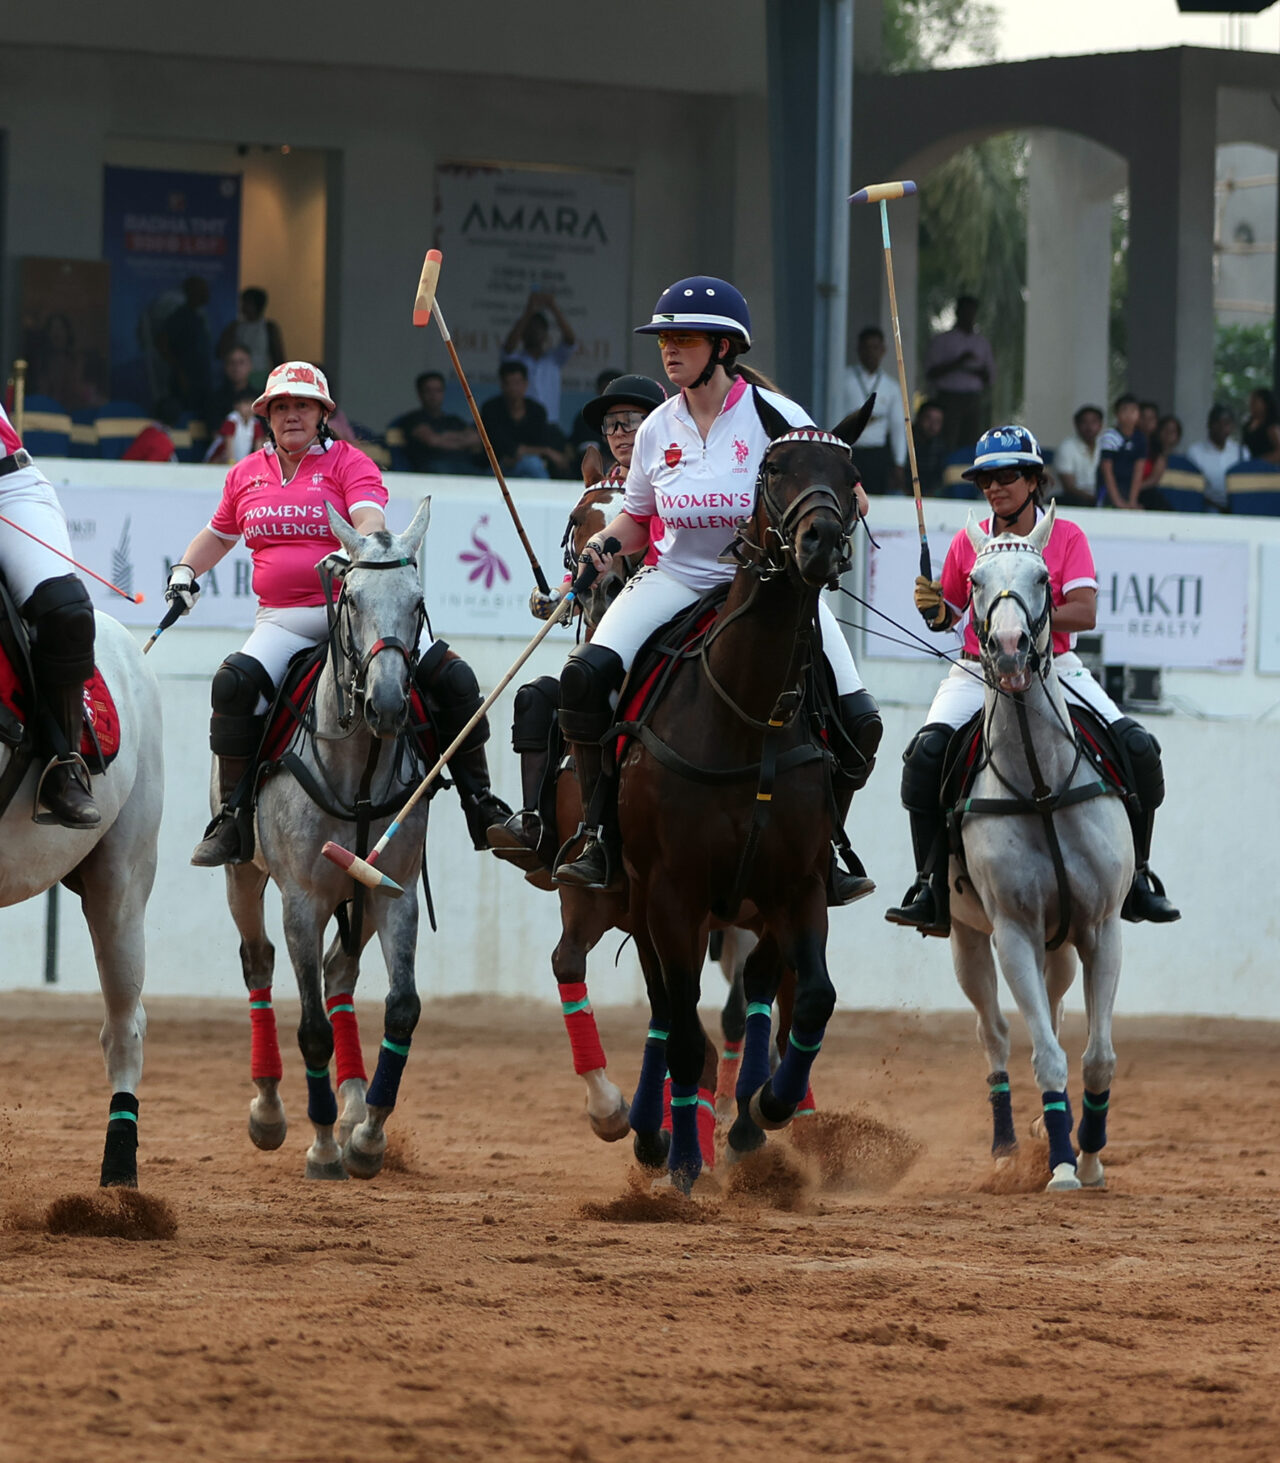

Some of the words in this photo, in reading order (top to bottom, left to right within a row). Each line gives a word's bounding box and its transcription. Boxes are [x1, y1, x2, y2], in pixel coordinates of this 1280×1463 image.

[461, 200, 608, 245] AMARA
[661, 493, 751, 509] WOMEN'S
[245, 505, 323, 521] WOMEN'S
[244, 523, 329, 540] CHALLENGE
[1128, 619, 1202, 639] REALTY
